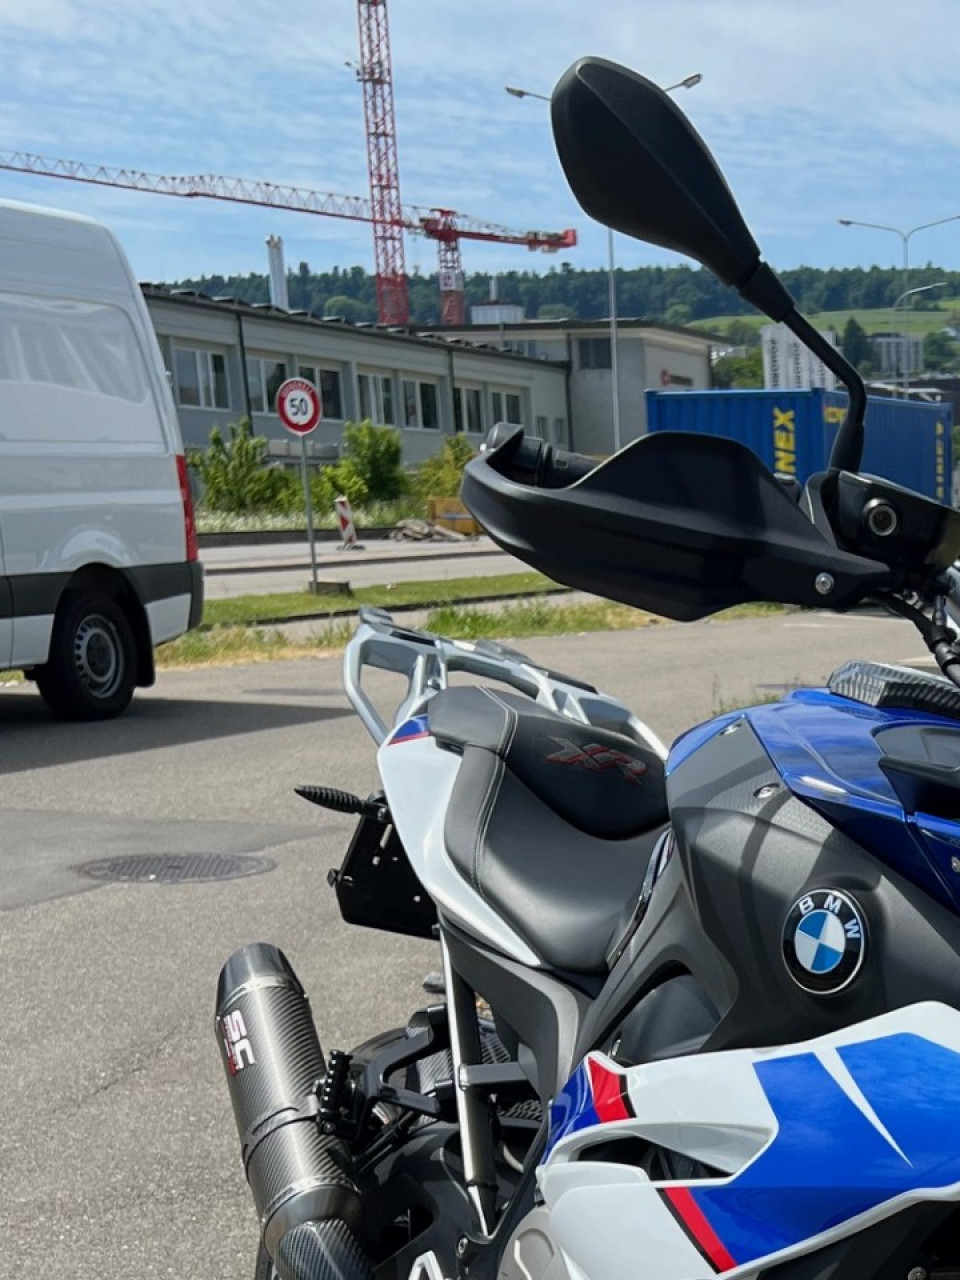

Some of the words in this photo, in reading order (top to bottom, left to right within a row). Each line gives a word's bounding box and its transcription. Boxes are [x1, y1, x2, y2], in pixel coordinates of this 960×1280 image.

[289, 397, 309, 417] 50
[772, 406, 796, 474] NEX
[544, 735, 648, 787] XR
[798, 894, 861, 939] BMW
